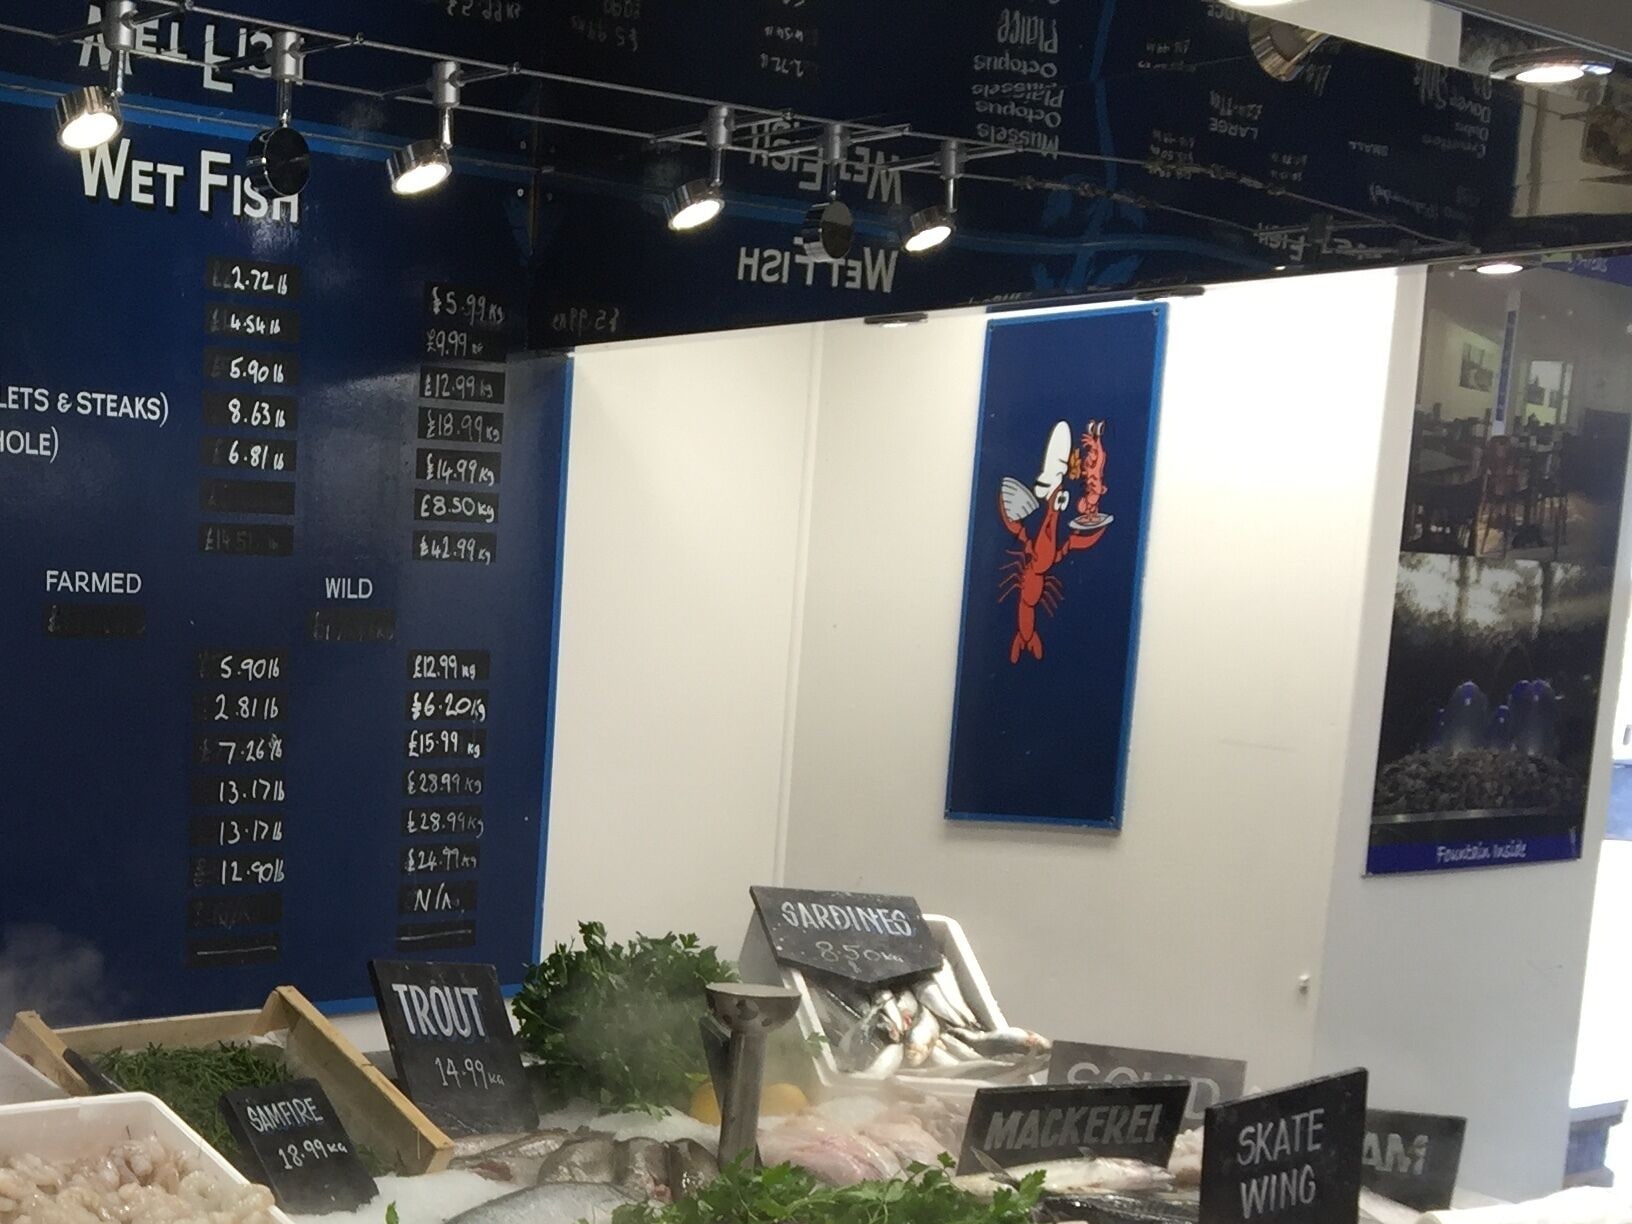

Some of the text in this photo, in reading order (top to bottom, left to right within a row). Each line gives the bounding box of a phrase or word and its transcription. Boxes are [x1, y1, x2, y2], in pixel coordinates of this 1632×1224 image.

[57, 391, 73, 413] &
[76, 391, 169, 428] STEAKS)
[46, 569, 142, 594] FARMED
[325, 577, 373, 599] WILD
[781, 901, 912, 937] SARDINES
[392, 983, 486, 1038] TROUT
[246, 1097, 323, 1133] SAMFIRE
[1237, 1108, 1324, 1166] SKATE
[1240, 1164, 1316, 1219] WING
